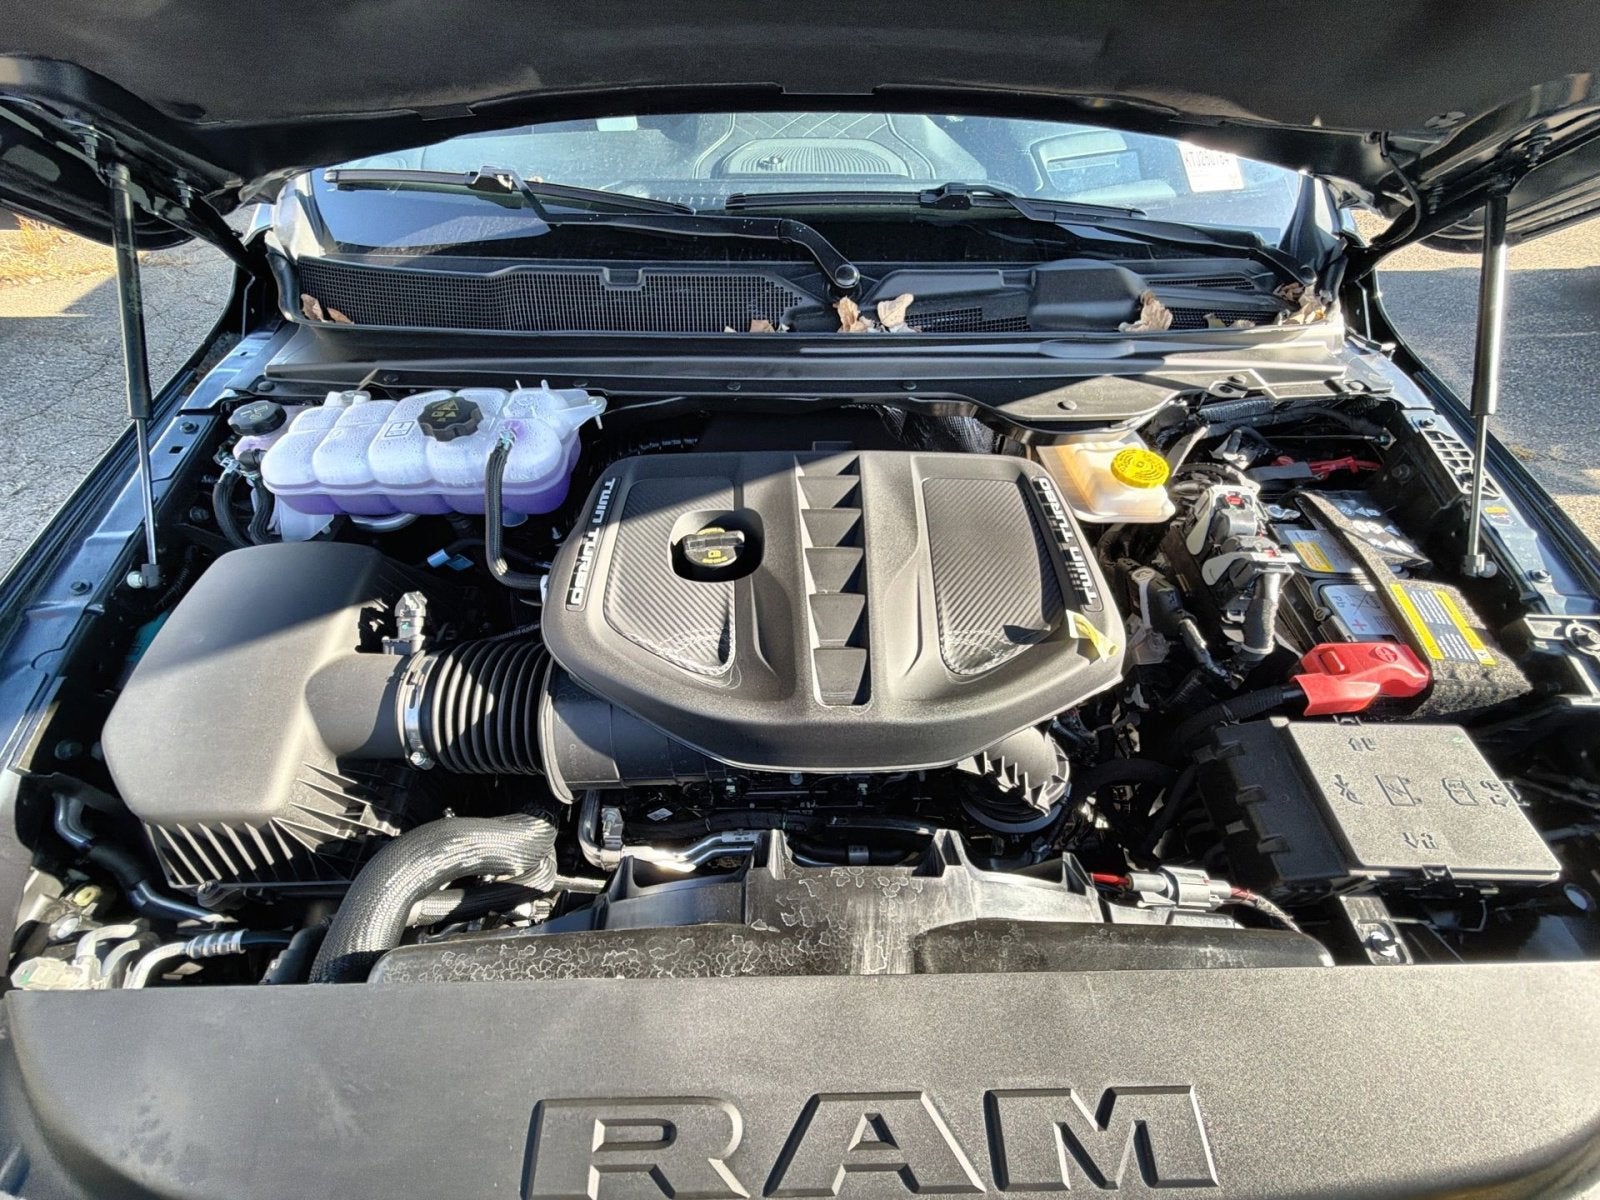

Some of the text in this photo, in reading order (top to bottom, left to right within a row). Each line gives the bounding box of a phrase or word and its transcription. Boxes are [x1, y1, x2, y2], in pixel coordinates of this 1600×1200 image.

[570, 477, 616, 605] TWIN TURBO
[1038, 477, 1097, 604] TWIN TURBO
[519, 1084, 1219, 1199] RAM
